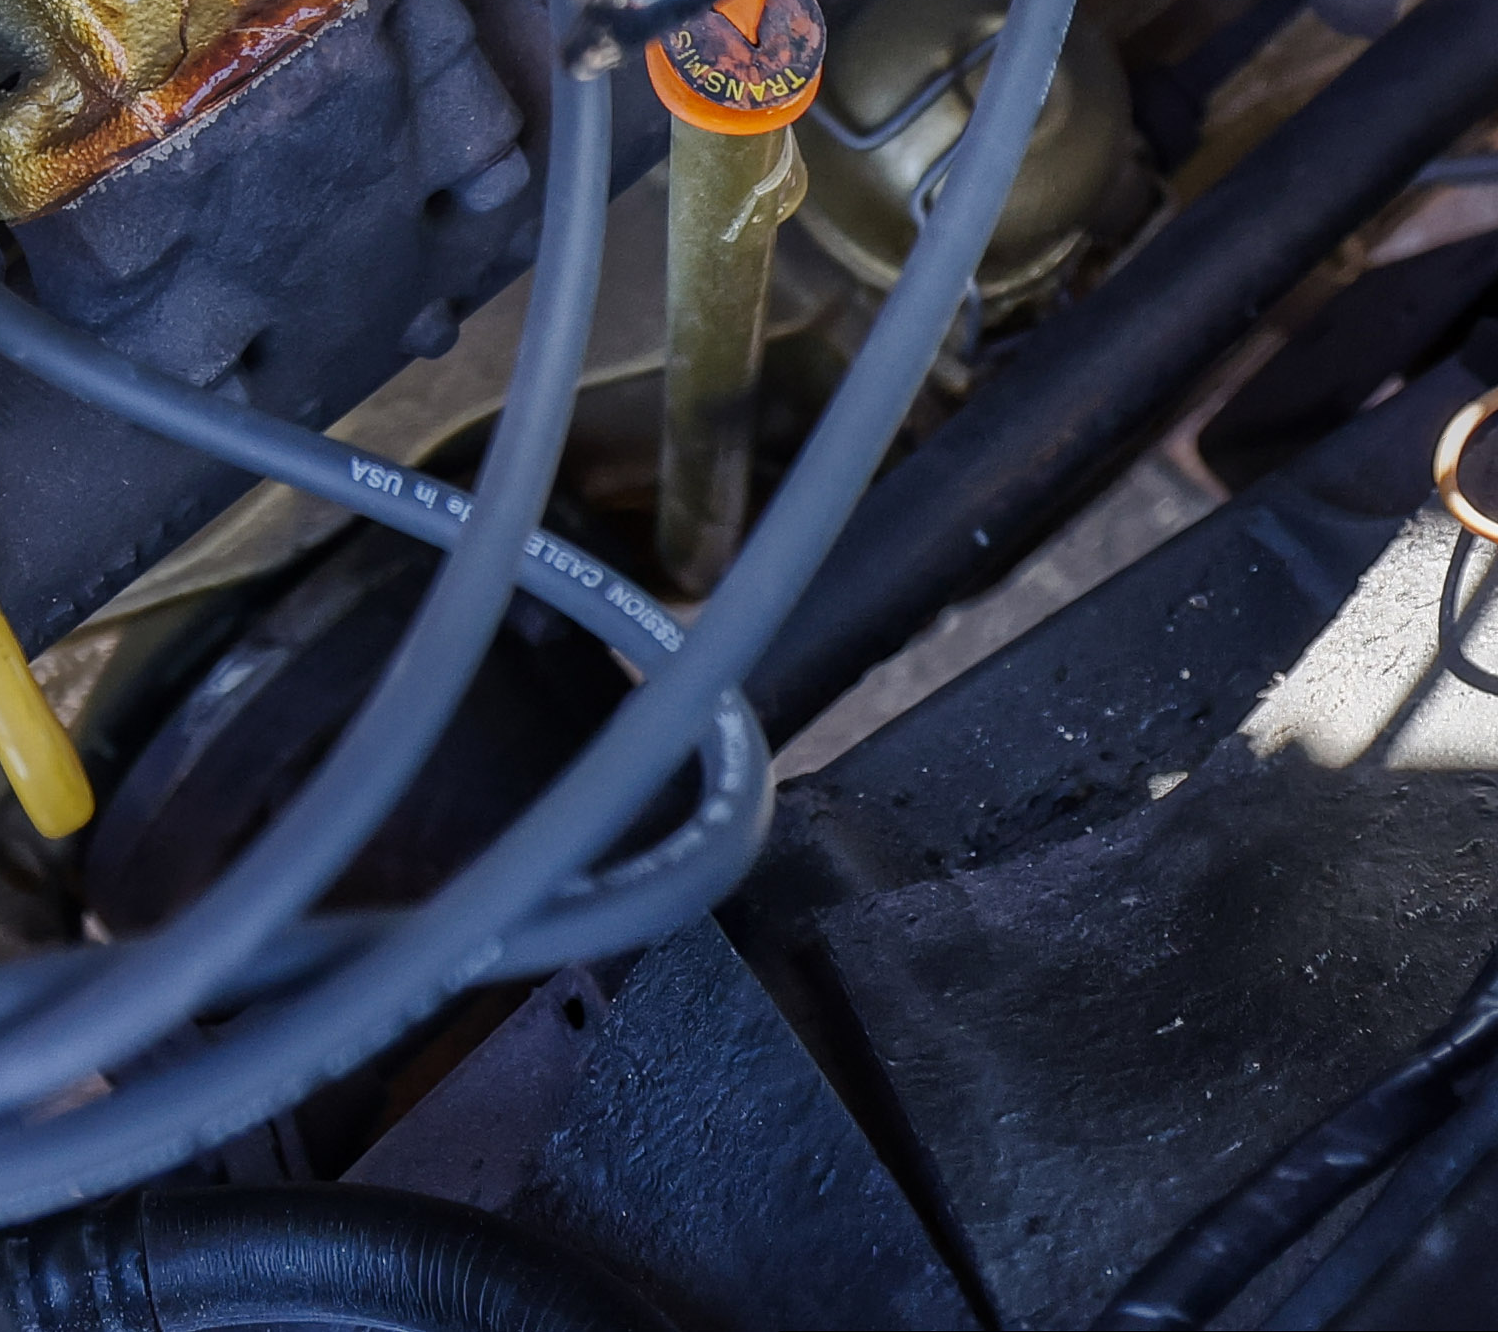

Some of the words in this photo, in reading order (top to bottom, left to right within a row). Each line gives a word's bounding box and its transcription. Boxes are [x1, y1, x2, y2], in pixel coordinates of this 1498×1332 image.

[670, 20, 807, 103] TRANSMIS
[350, 455, 404, 497] USA
[413, 480, 440, 510] in
[523, 532, 606, 589] CABLE
